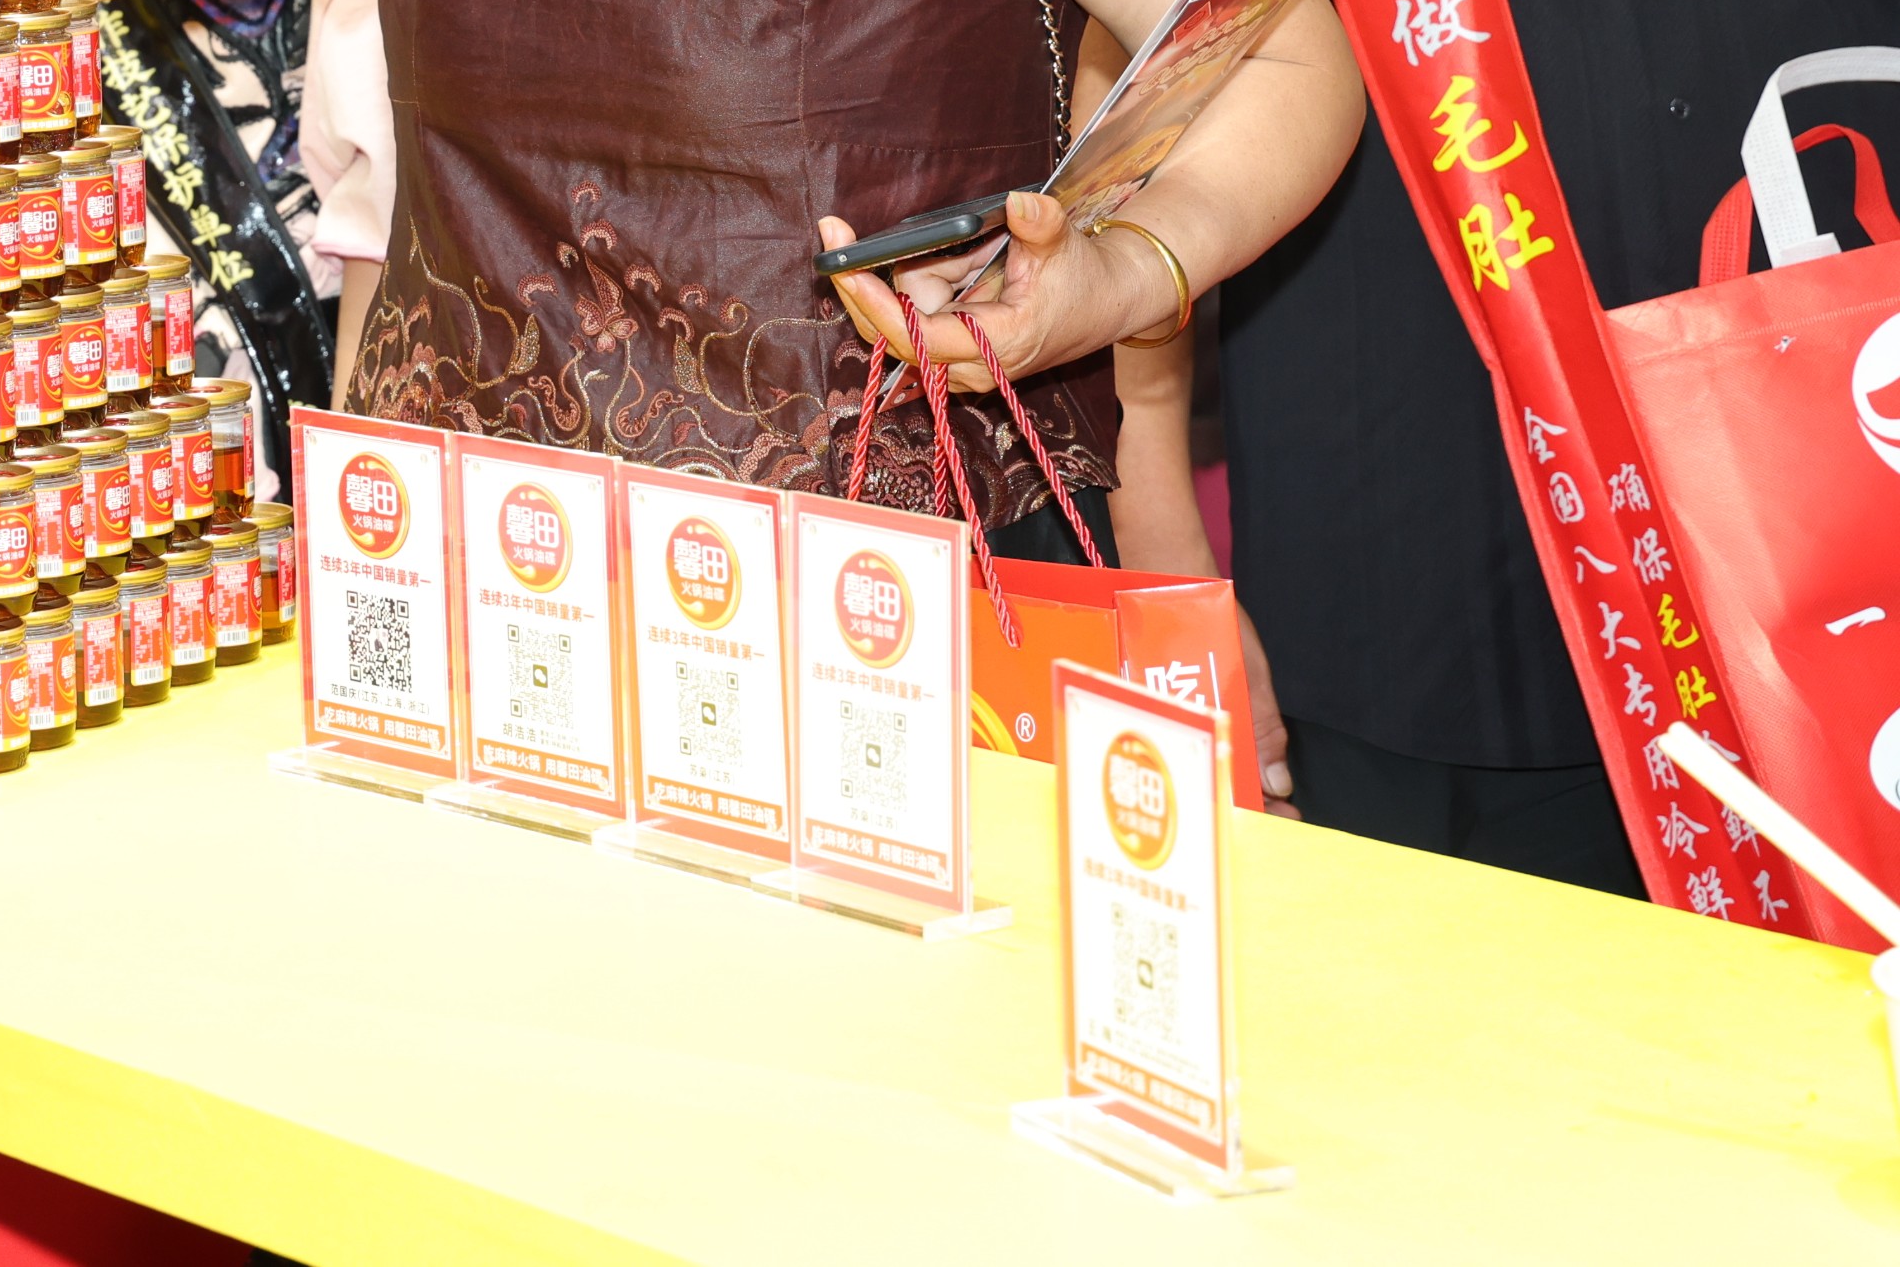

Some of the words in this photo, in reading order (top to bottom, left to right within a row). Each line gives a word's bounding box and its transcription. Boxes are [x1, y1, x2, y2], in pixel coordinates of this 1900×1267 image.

[21, 210, 57, 234] 馨田
[26, 233, 56, 244] 火锅油碟
[68, 340, 102, 364] 馨田
[47, 354, 63, 378] 馨
[345, 473, 398, 516] 馨田
[352, 513, 394, 534] 火锅油碟
[505, 503, 559, 549] 馨田
[512, 545, 556, 567] 火锅油碟
[673, 537, 729, 585] 馨田
[320, 554, 432, 588] 连续3年中国销量第一
[680, 581, 725, 602] 火锅油碟
[843, 571, 900, 622] 馨田
[479, 587, 594, 623] 连续3年中国销量第一
[849, 617, 896, 641] 火锅油碟
[647, 624, 764, 662] 连续3年中国销量第一
[10, 677, 29, 702] 馨
[811, 662, 935, 701] 连续3年中国销量第一
[503, 723, 536, 743] 胡浩浩
[1109, 754, 1165, 817] 馨田
